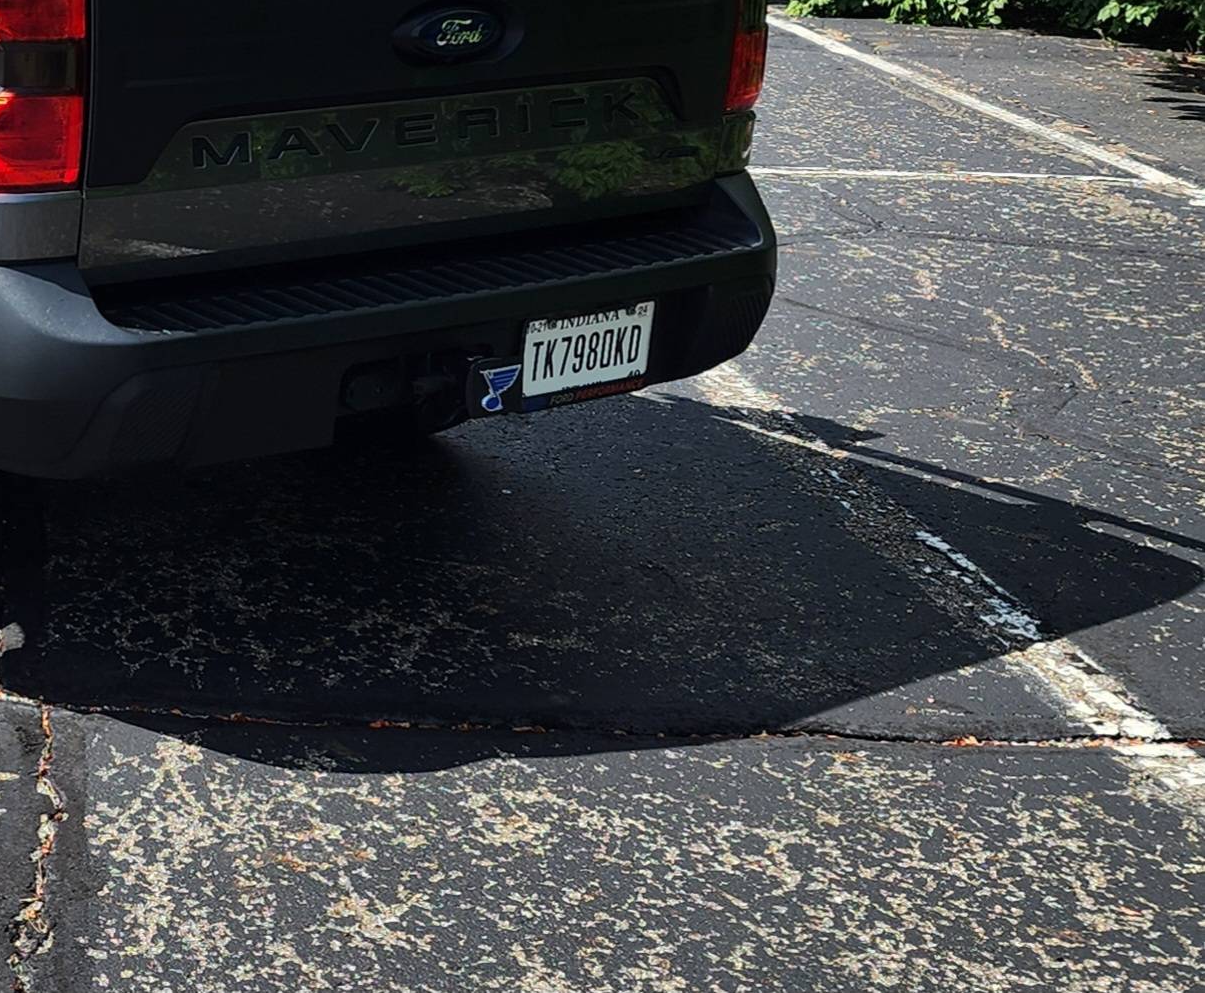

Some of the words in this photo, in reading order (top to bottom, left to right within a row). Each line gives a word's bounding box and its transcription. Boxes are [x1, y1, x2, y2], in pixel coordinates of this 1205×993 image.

[436, 19, 484, 46] Ford
[192, 91, 645, 169] MAVERICK
[560, 309, 620, 330] INDIANA
[532, 324, 642, 381] TK798DKD
